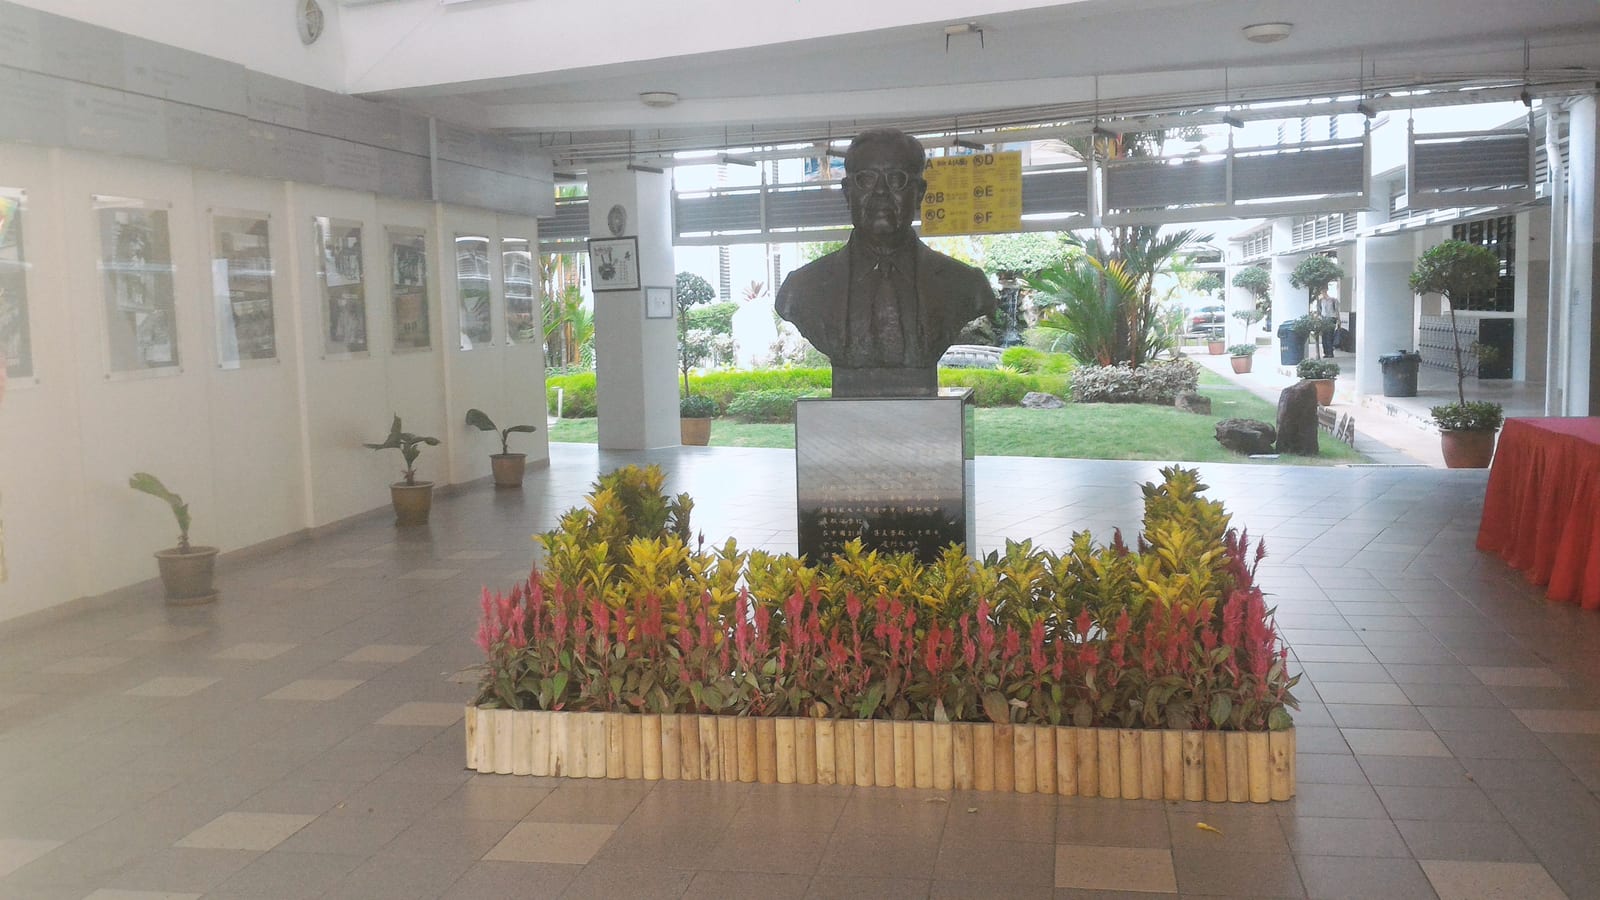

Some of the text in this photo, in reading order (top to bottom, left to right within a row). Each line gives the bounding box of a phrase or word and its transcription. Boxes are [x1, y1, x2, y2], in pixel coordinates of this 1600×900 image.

[925, 158, 933, 169] A
[985, 154, 993, 165] D
[985, 185, 993, 196] E
[936, 192, 944, 202] B
[937, 208, 945, 219] C
[985, 212, 993, 222] F
